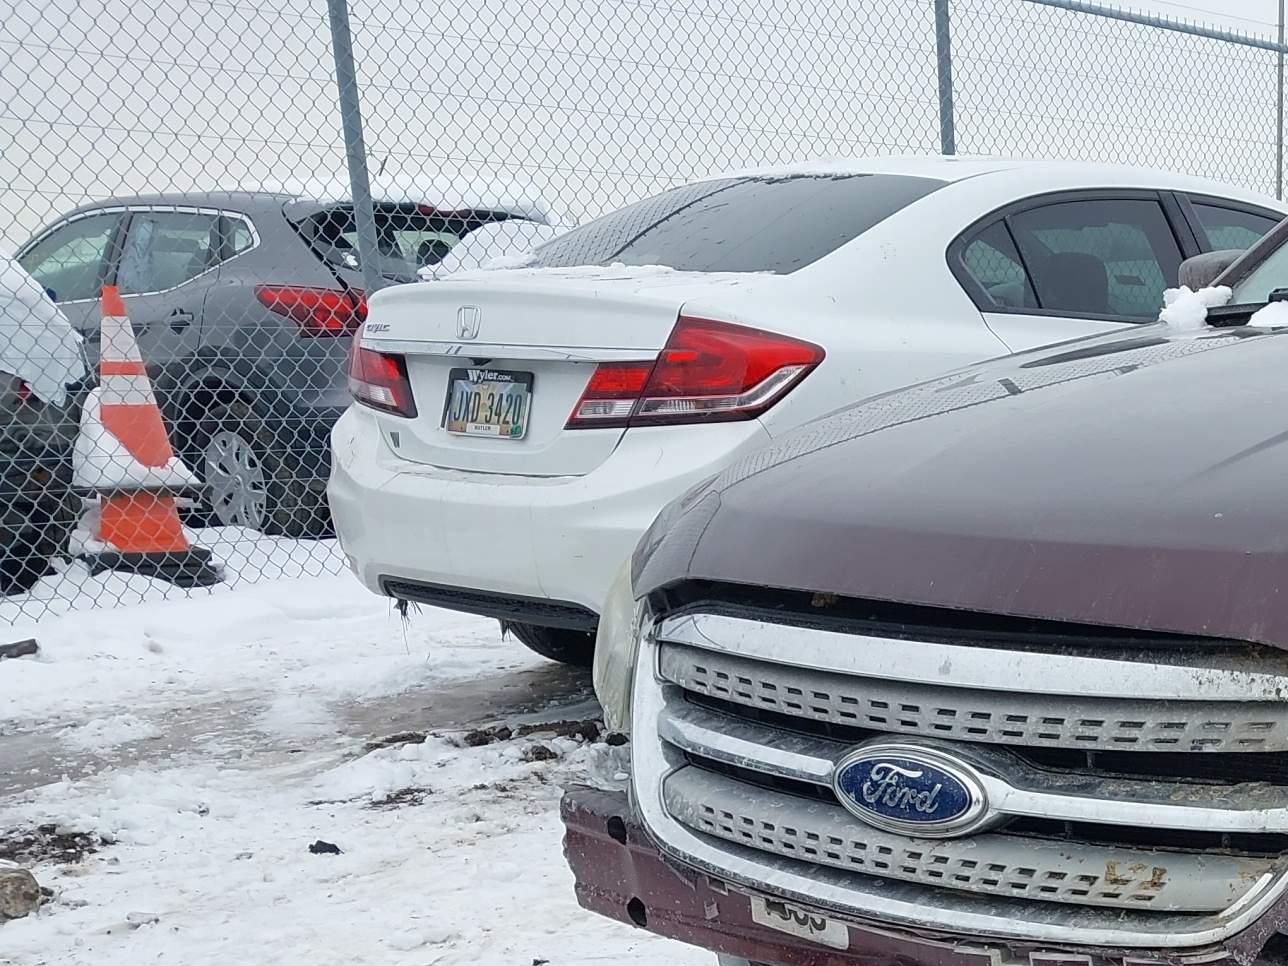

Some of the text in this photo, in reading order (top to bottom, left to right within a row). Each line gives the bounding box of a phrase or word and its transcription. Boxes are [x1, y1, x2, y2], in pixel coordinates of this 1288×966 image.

[453, 390, 523, 426] JXD 3420
[862, 762, 943, 814] Ford
